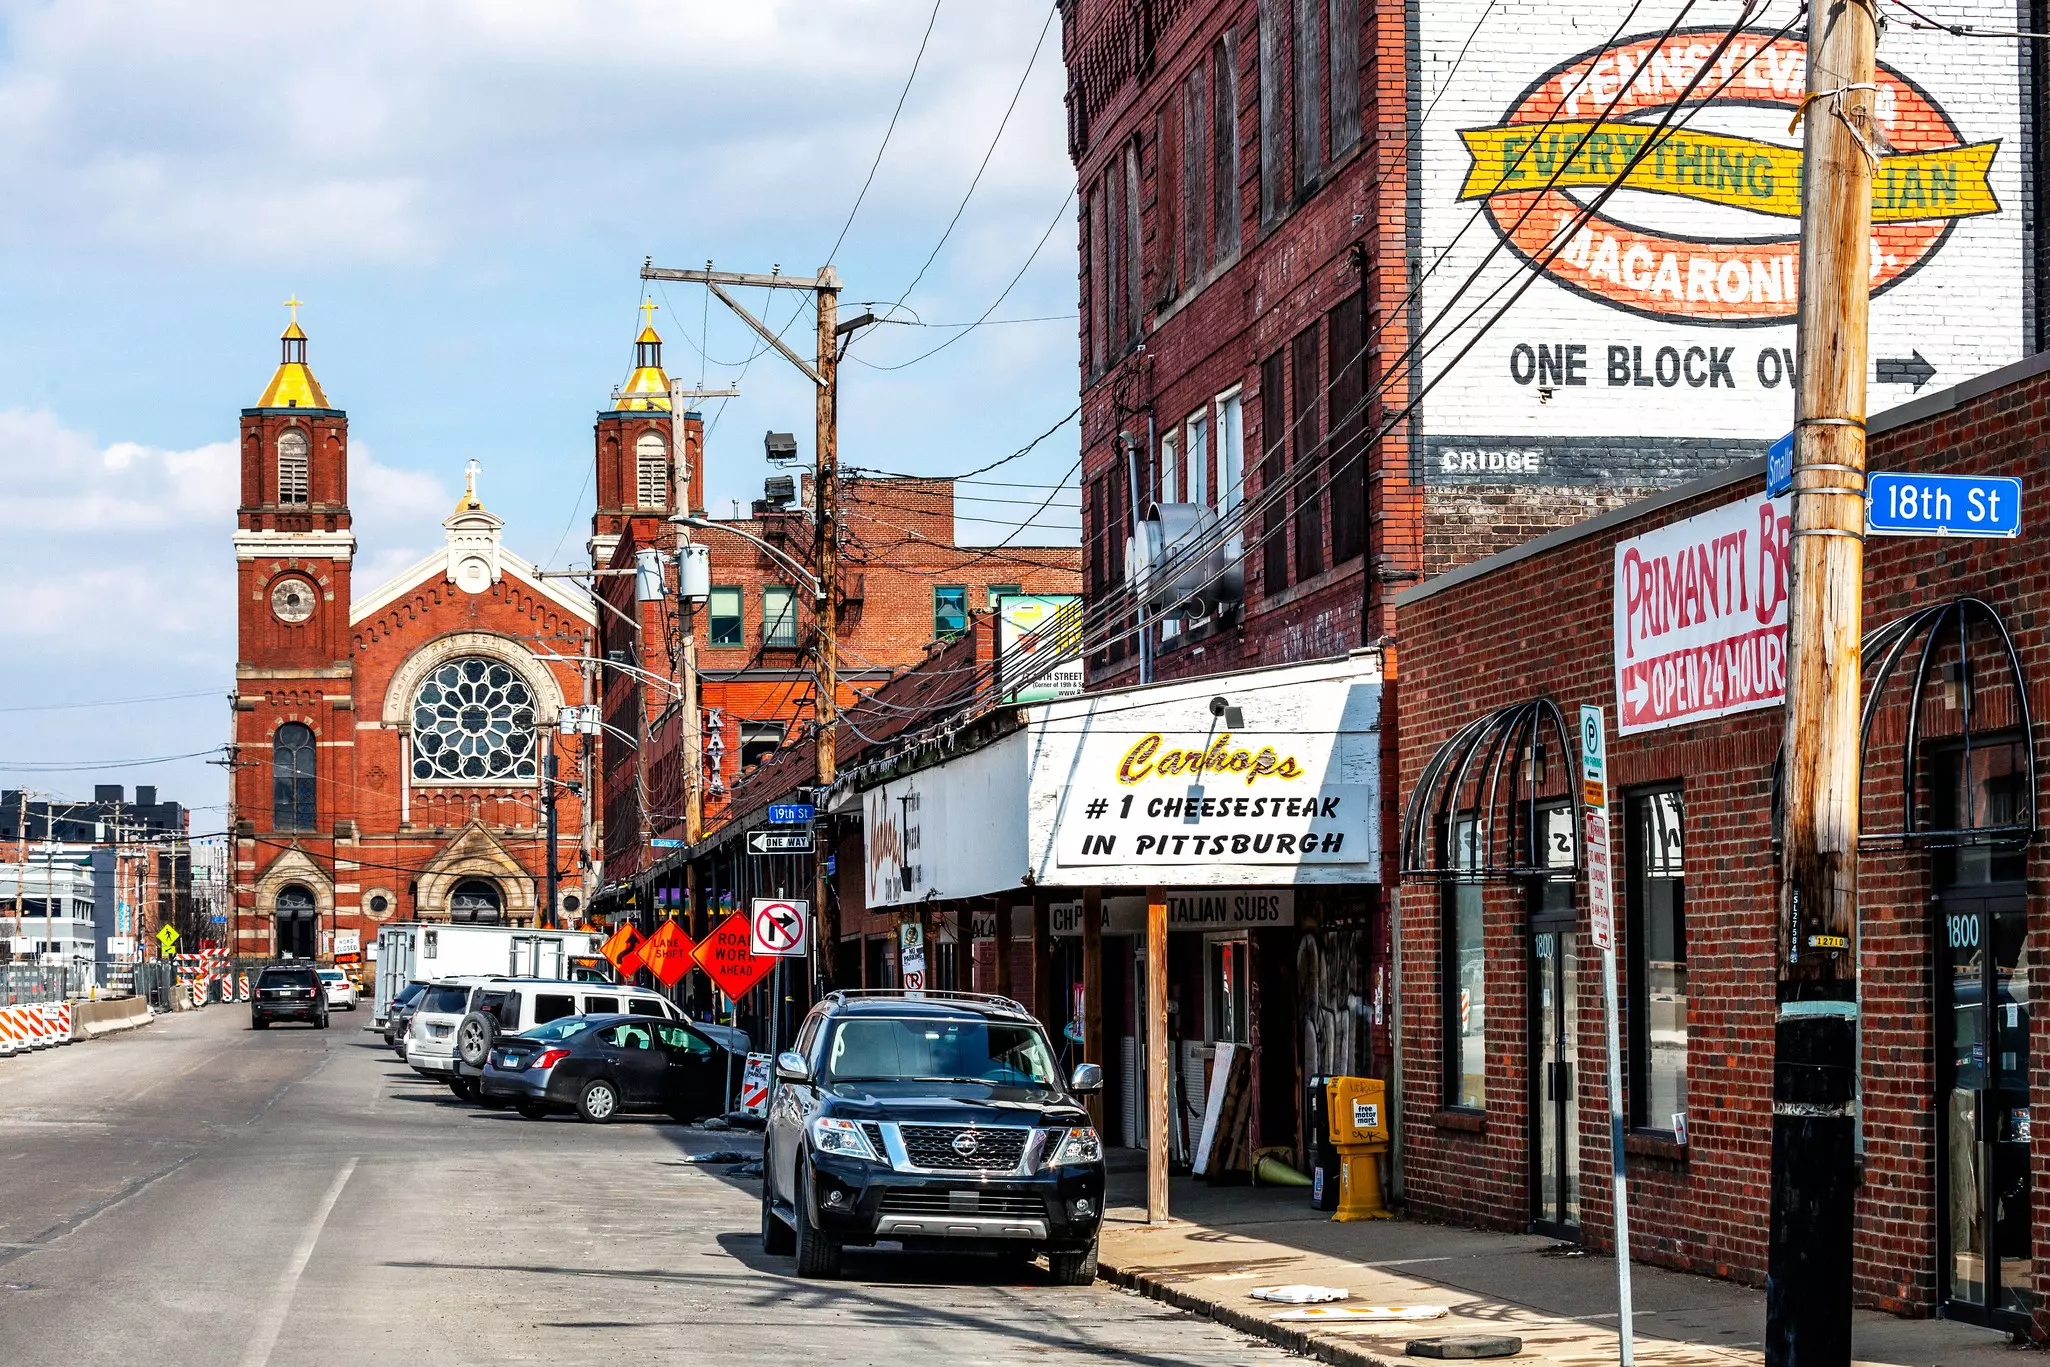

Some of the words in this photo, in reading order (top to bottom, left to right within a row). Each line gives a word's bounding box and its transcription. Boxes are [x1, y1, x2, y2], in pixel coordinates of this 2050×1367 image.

[1502, 133, 1774, 198] EVERYTHING
[1553, 212, 1797, 302] MACARONI
[1510, 343, 1587, 387] ONE
[1607, 346, 1736, 389] BLOCK
[1442, 451, 1539, 473] CRIDGE
[1888, 484, 1952, 520] 18th
[1967, 487, 2001, 522] St
[1054, 672, 1083, 681] STREET
[1651, 651, 1699, 716] OPEN
[1702, 648, 1724, 706] 24
[1115, 733, 1303, 786] Carhops
[774, 808, 796, 820] 19th
[797, 808, 809, 819] St
[1085, 798, 1109, 818] #
[1119, 794, 1135, 819] 1
[1146, 797, 1341, 818] CHEESESTEAK
[765, 837, 784, 848] ONE
[787, 836, 807, 848] WAY
[1080, 834, 1116, 855] IN
[1136, 832, 1345, 855] PITTSBURGH
[1167, 897, 1227, 924] TALIAN
[1233, 895, 1280, 922] SUBS
[1817, 937, 1844, 946] 12710
[1947, 914, 1979, 948] 1800
[653, 939, 679, 948] LANE
[655, 949, 684, 958] SHIFT
[1535, 934, 1554, 958] 1800
[720, 965, 753, 977] AHEAD
